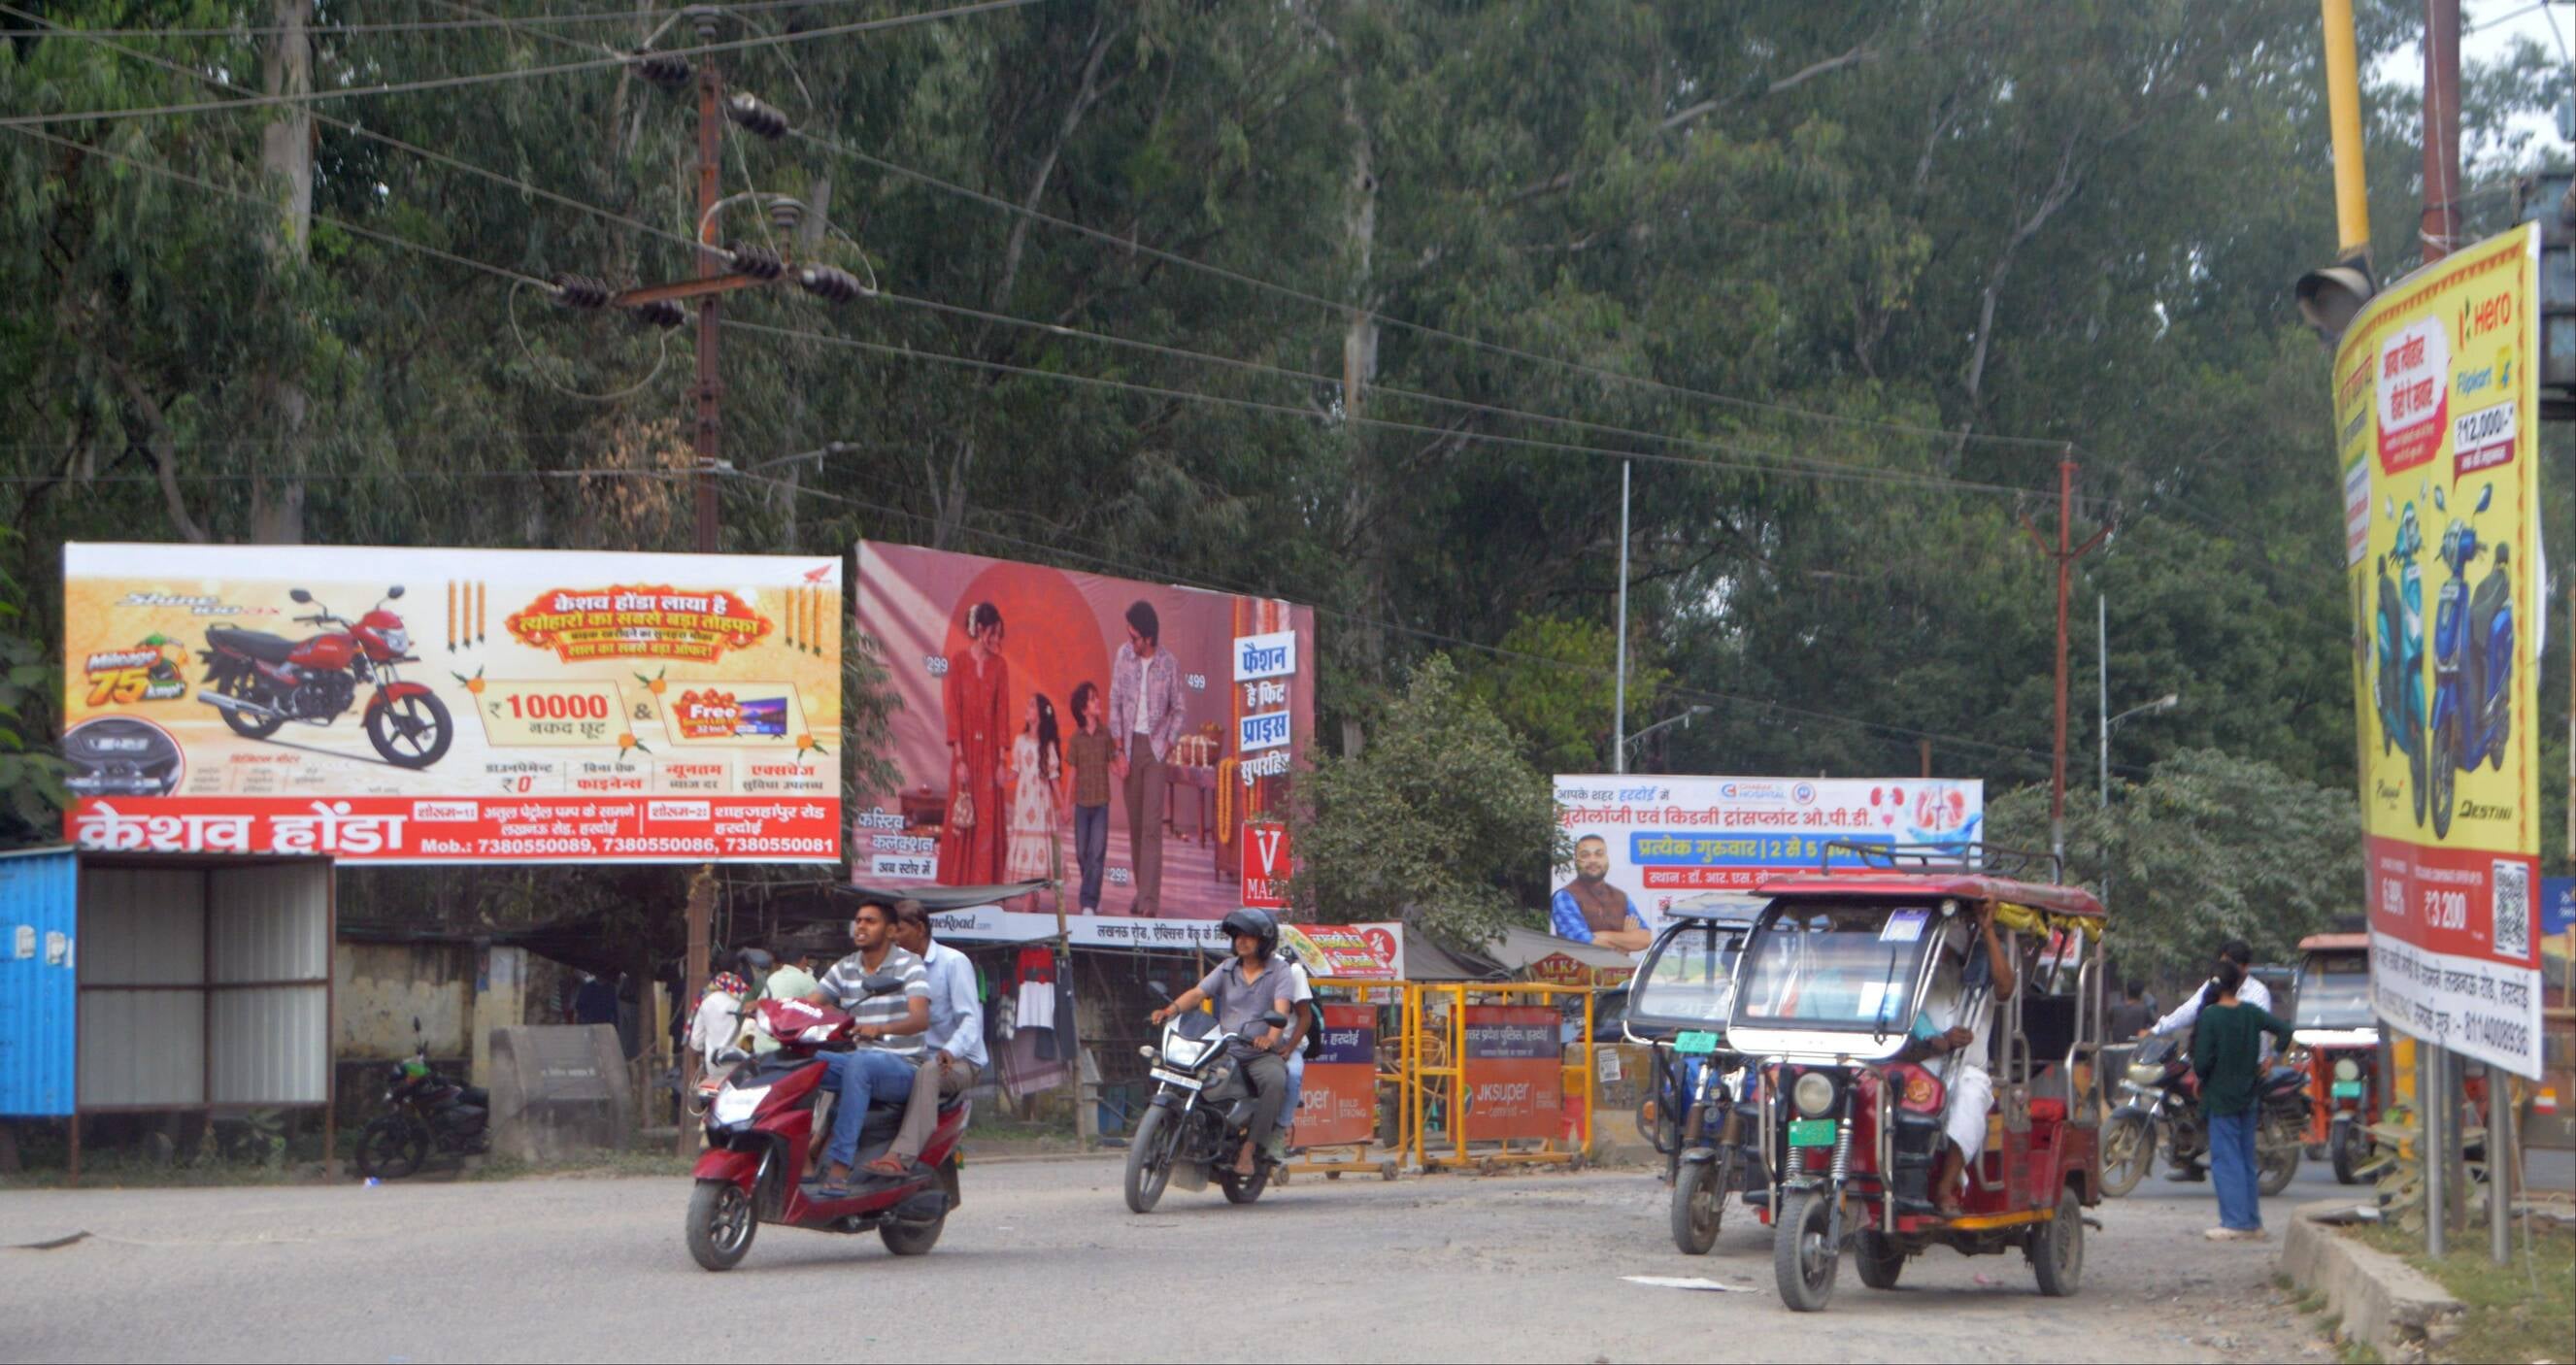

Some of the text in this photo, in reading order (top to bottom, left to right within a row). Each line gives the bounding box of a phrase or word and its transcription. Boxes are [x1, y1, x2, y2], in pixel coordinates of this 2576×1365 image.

[2474, 291, 2511, 337] Hero
[553, 591, 729, 615] केशव होंडा लाया है
[588, 612, 614, 628] का
[617, 611, 661, 628] सबसे
[87, 649, 157, 671] Mileage
[1243, 642, 1288, 674] फैशन
[86, 669, 150, 707] 75
[1244, 681, 1285, 709] है फिट
[507, 693, 608, 719] 10000
[634, 702, 652, 720] &
[689, 704, 736, 719] Free
[529, 721, 607, 739] नकद छूट
[1243, 714, 1288, 745] प्राइस
[666, 763, 722, 779] न्यूनतम
[1556, 784, 1670, 802] आपके शहर हरदोई में
[583, 802, 596, 817] के
[599, 802, 635, 817] सामने
[800, 802, 825, 819] रोड
[1636, 807, 1663, 824] एवं
[1664, 805, 1720, 825] किडनी
[1723, 806, 1799, 826] ट्रांसप्लांट
[76, 801, 408, 854] केशव होंडा
[580, 818, 619, 836] हरदोई
[715, 818, 763, 836] हरदोई
[420, 839, 473, 853] Mob.:
[725, 837, 833, 852] 7380550081
[1255, 829, 1282, 877] V
[1637, 834, 1692, 857] प्रत्येक
[1770, 840, 1782, 858] 2
[1785, 835, 1801, 858] से
[1805, 840, 1818, 858] 5
[879, 859, 932, 876] अब स्टोर में
[1096, 923, 1128, 939] लखनऊ
[1187, 923, 1201, 940] बैंक
[1203, 923, 1212, 940] के
[1330, 1029, 1360, 1047] हरदोई
